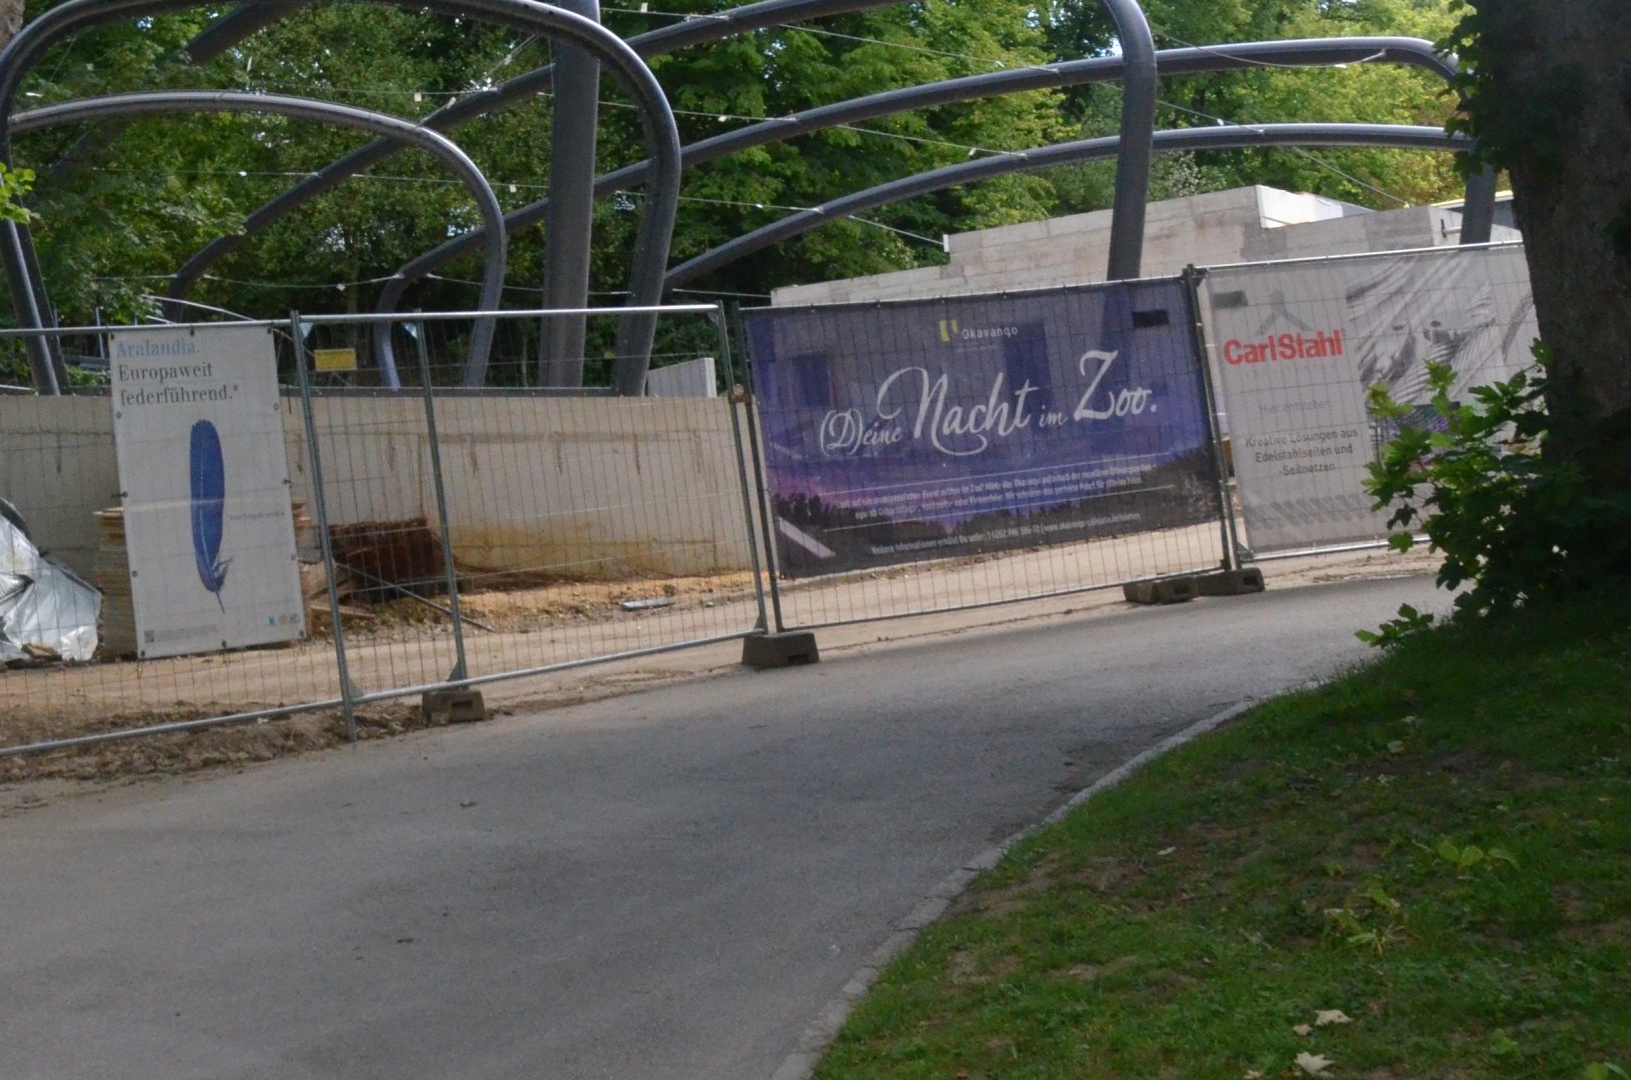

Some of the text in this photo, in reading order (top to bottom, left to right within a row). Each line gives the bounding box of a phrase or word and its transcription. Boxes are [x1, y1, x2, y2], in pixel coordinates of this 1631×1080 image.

[962, 326, 1019, 340] Okavango
[117, 339, 201, 357] Aralandia.
[120, 362, 213, 383] Europaweit
[876, 366, 1039, 456] Nacht
[1039, 405, 1069, 428] im
[1073, 349, 1158, 421] Zoo.
[1245, 428, 1358, 448] Kreative Lösungen aus
[1335, 444, 1353, 455] und
